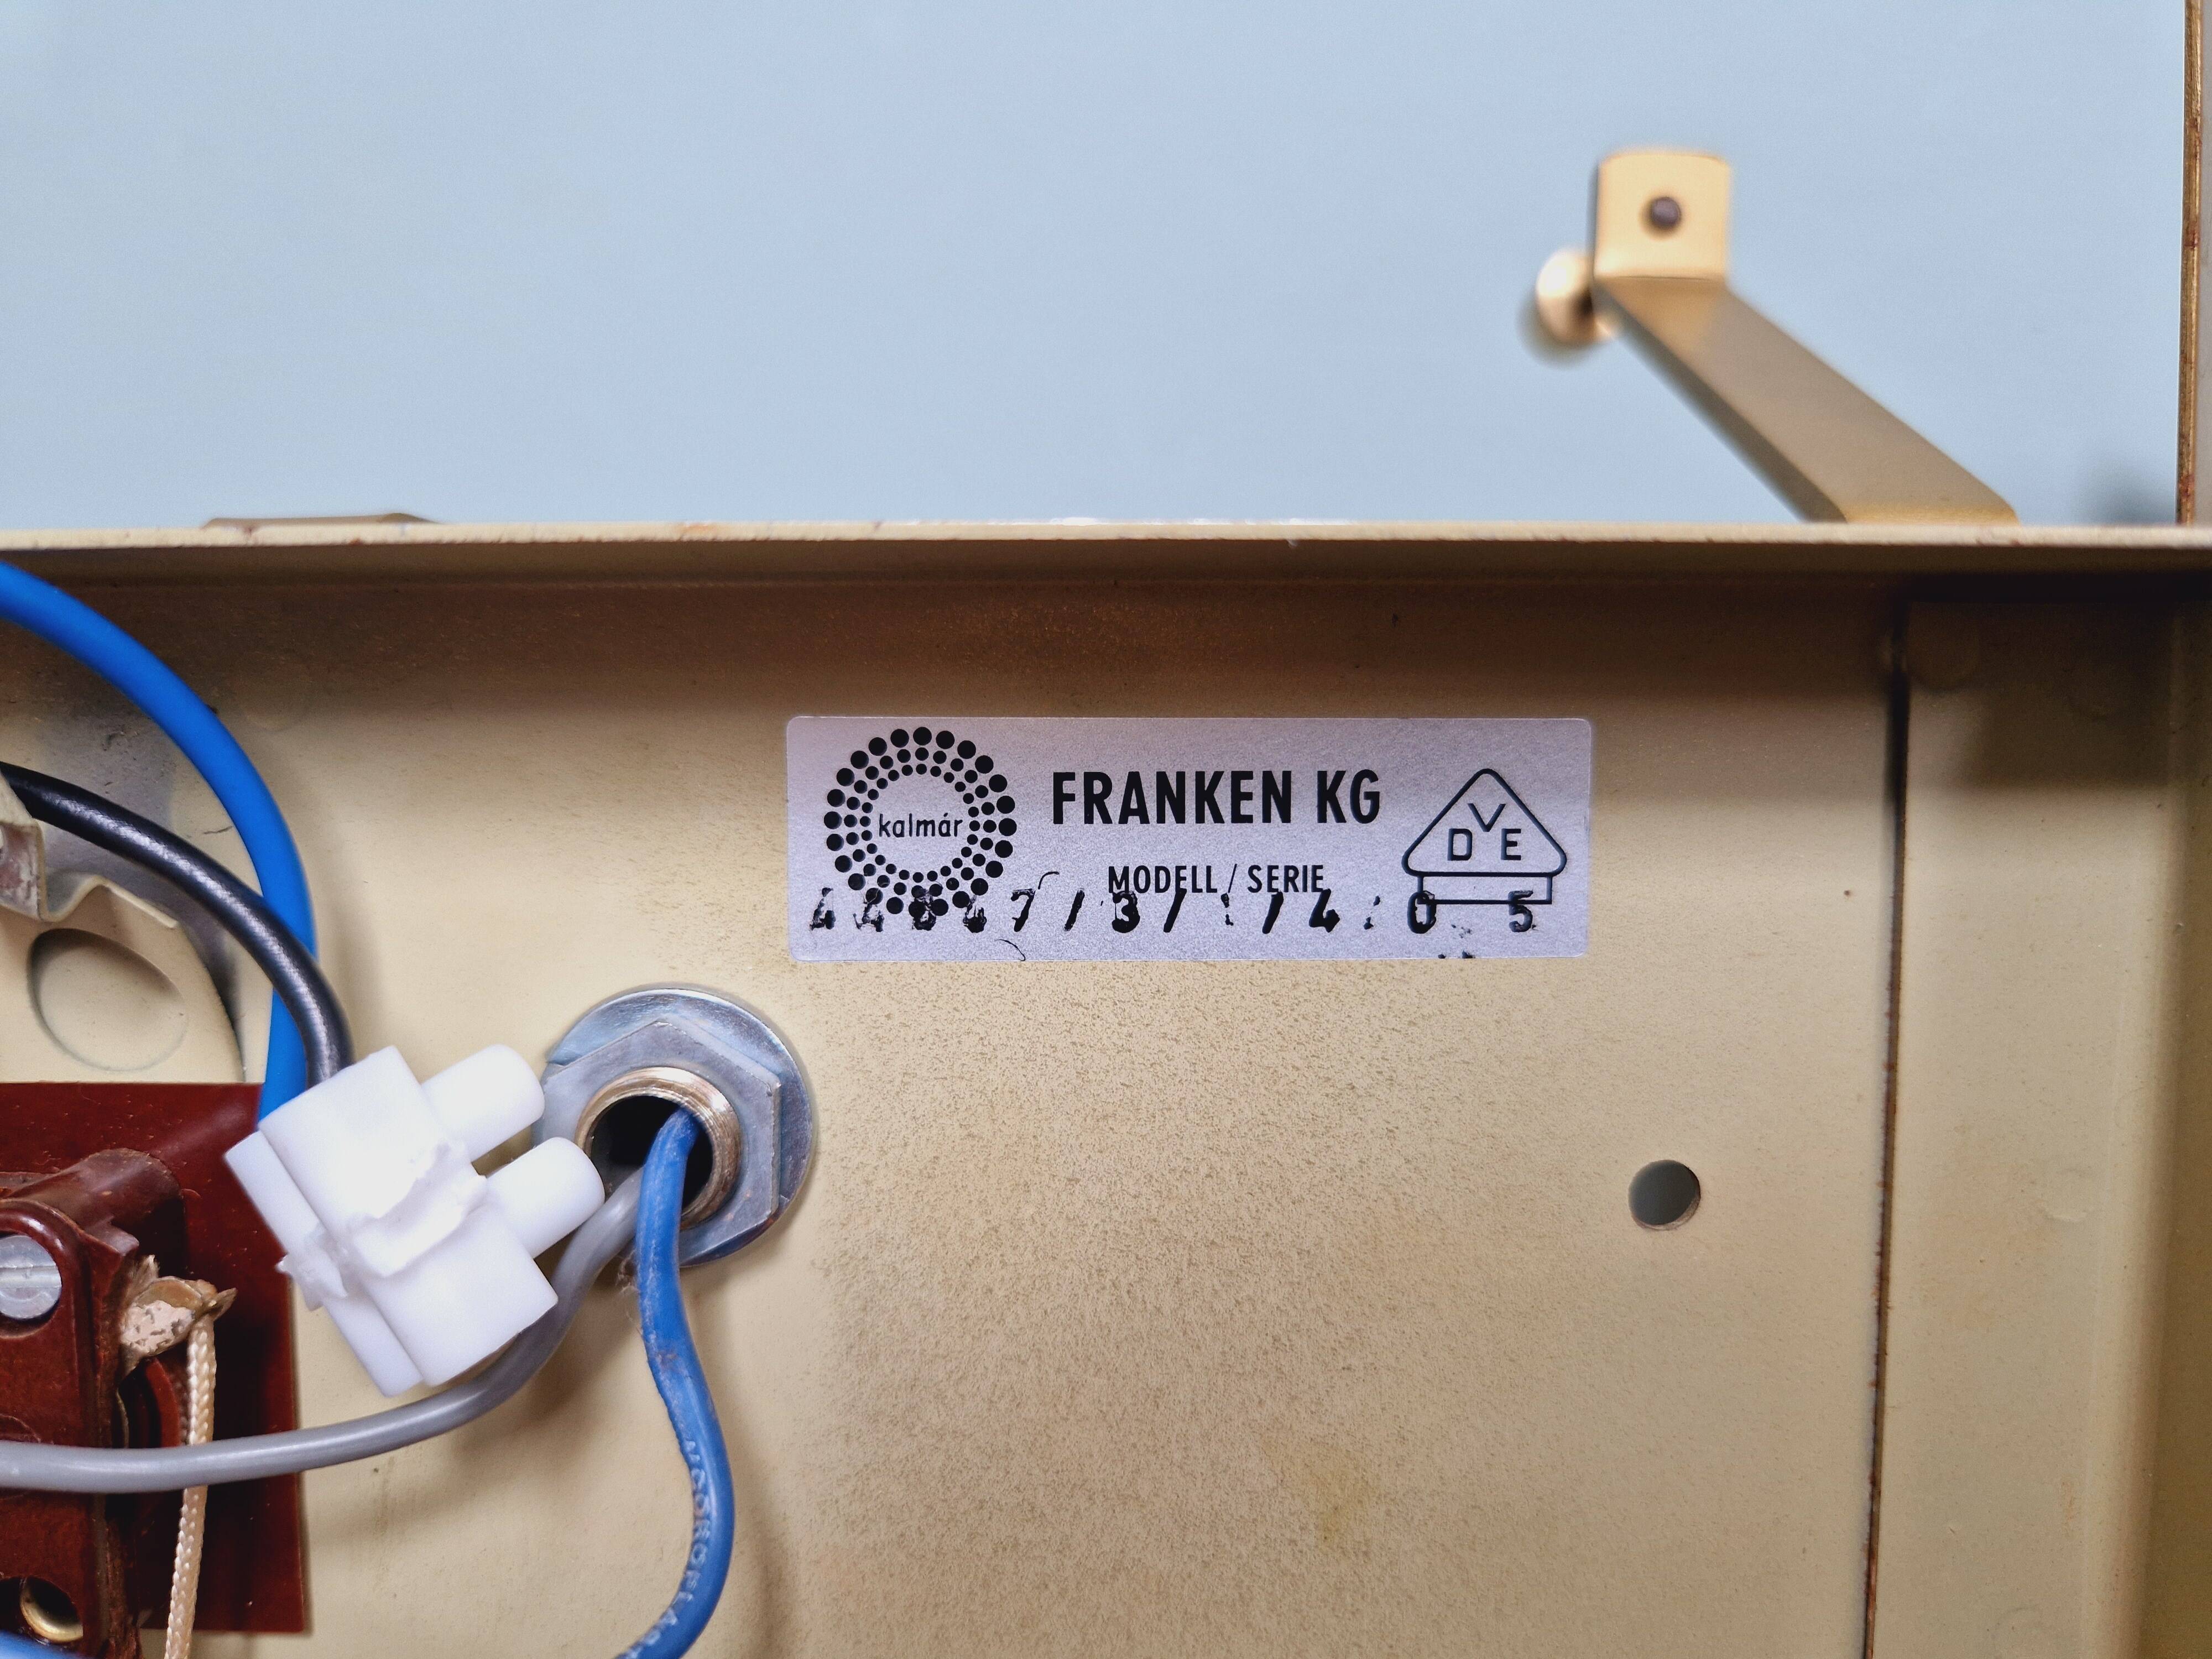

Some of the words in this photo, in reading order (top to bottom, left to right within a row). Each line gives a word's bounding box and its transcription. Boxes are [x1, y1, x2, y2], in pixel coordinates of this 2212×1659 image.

[1053, 770, 1292, 825] FRANKEN
[1316, 769, 1380, 824] KG
[879, 812, 963, 838] kalmár
